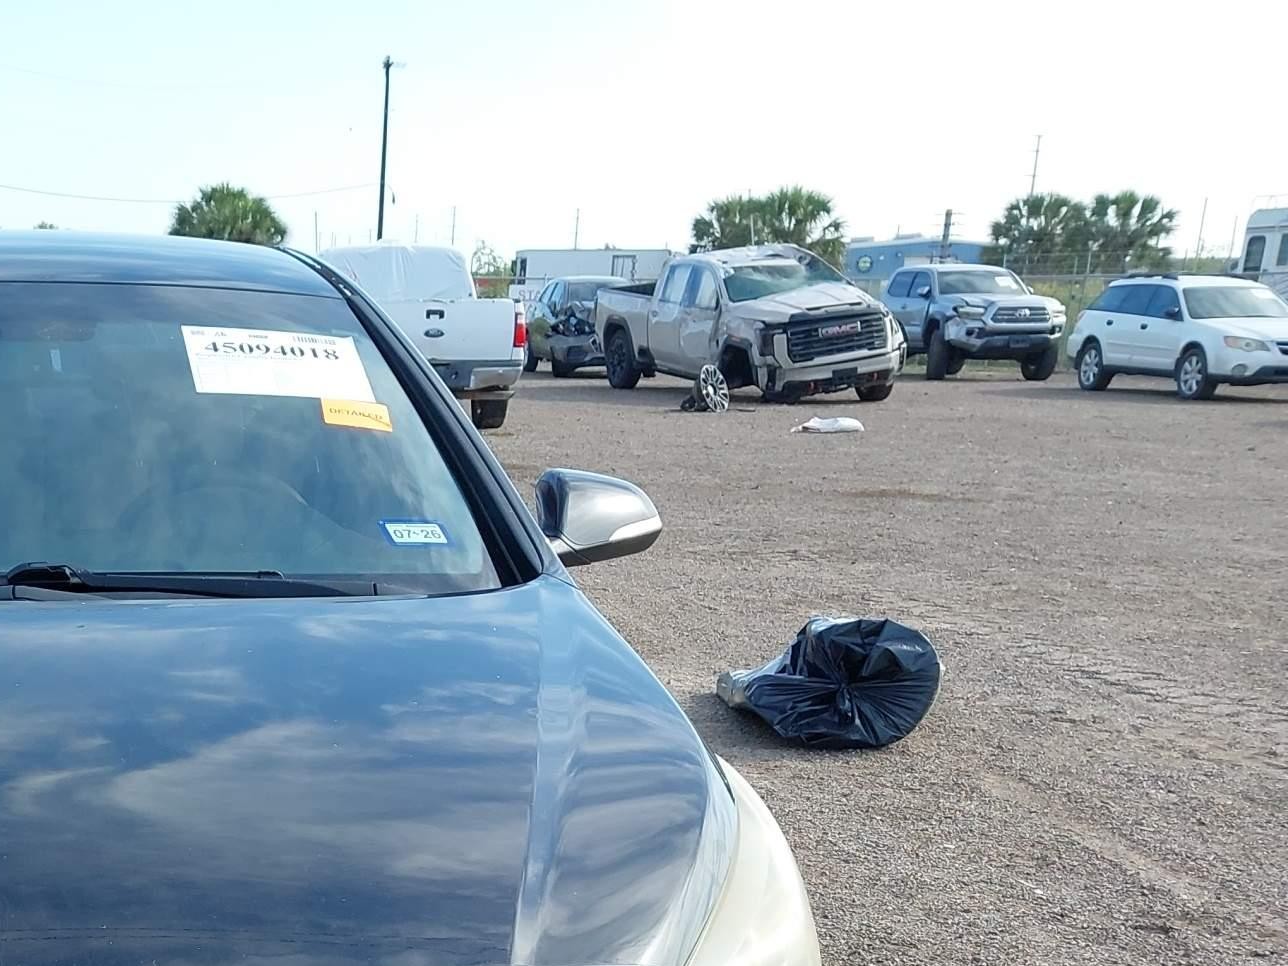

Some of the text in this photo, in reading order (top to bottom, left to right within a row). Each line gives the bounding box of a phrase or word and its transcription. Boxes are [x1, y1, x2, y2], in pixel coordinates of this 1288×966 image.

[204, 340, 340, 361] 45094018
[393, 529, 442, 539] 07 26
